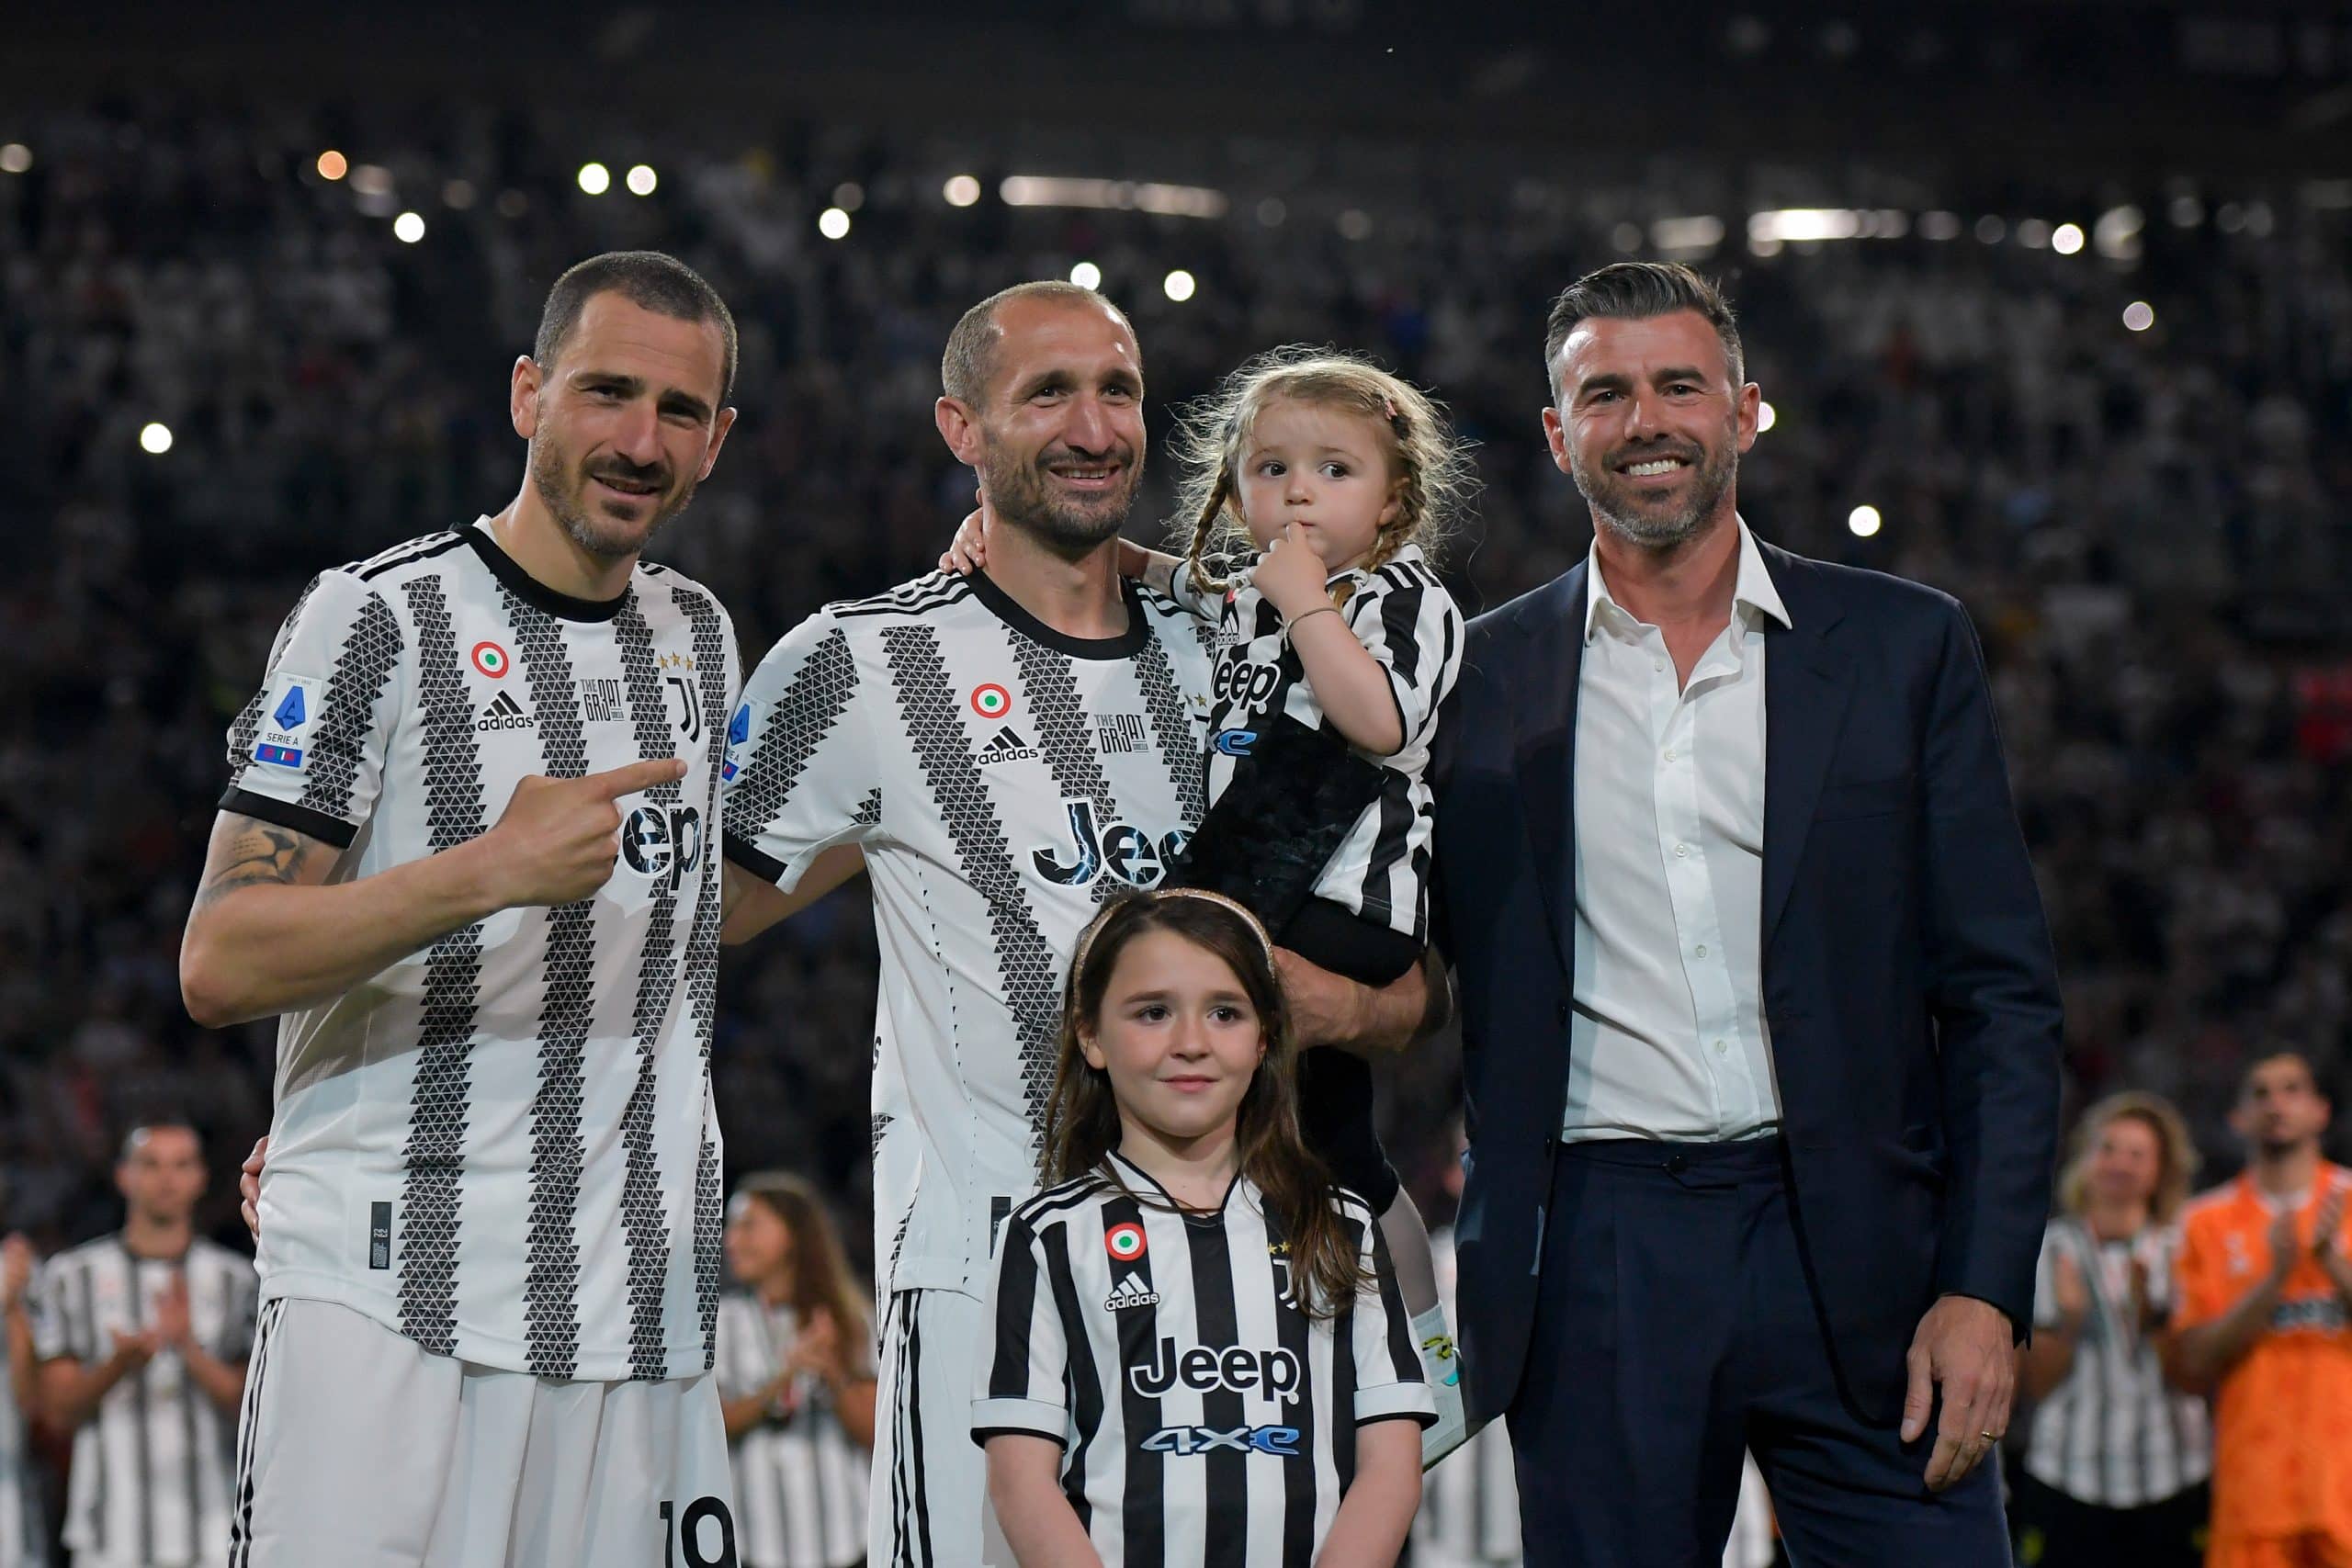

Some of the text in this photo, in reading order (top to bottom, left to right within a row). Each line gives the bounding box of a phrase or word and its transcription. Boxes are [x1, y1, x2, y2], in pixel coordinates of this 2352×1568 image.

[580, 679, 598, 693] THE
[477, 716, 535, 732] adidas
[1093, 714, 1115, 727] THE
[266, 732, 300, 746] SERIE A
[978, 747, 1039, 765] adidas
[1104, 1292, 1159, 1312] adidas
[1132, 1336, 1298, 1403] Jeep
